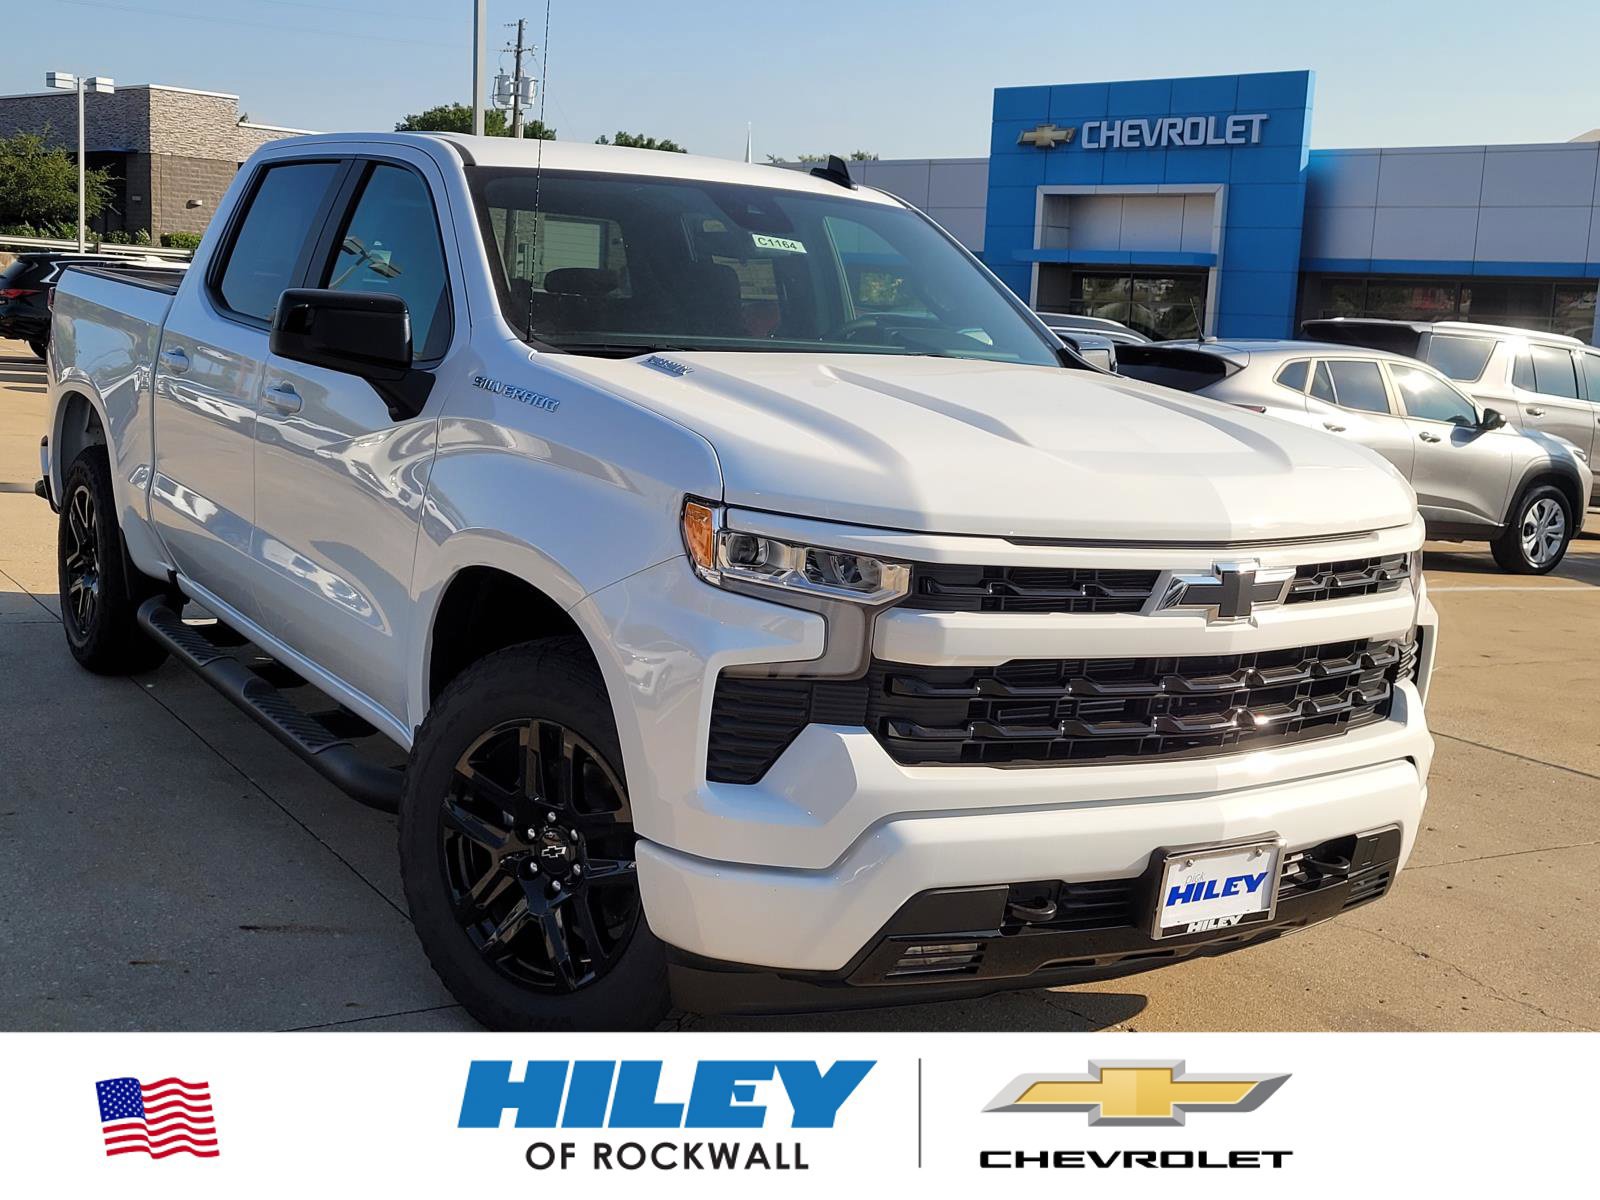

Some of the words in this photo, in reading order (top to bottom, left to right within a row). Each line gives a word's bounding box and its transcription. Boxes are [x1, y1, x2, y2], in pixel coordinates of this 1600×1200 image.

[1082, 114, 1268, 149] CHEVROLET
[757, 237, 798, 250] C1164
[473, 376, 560, 412] SILVERADO
[1166, 872, 1269, 906] HILEY
[1187, 914, 1244, 933] HILEY
